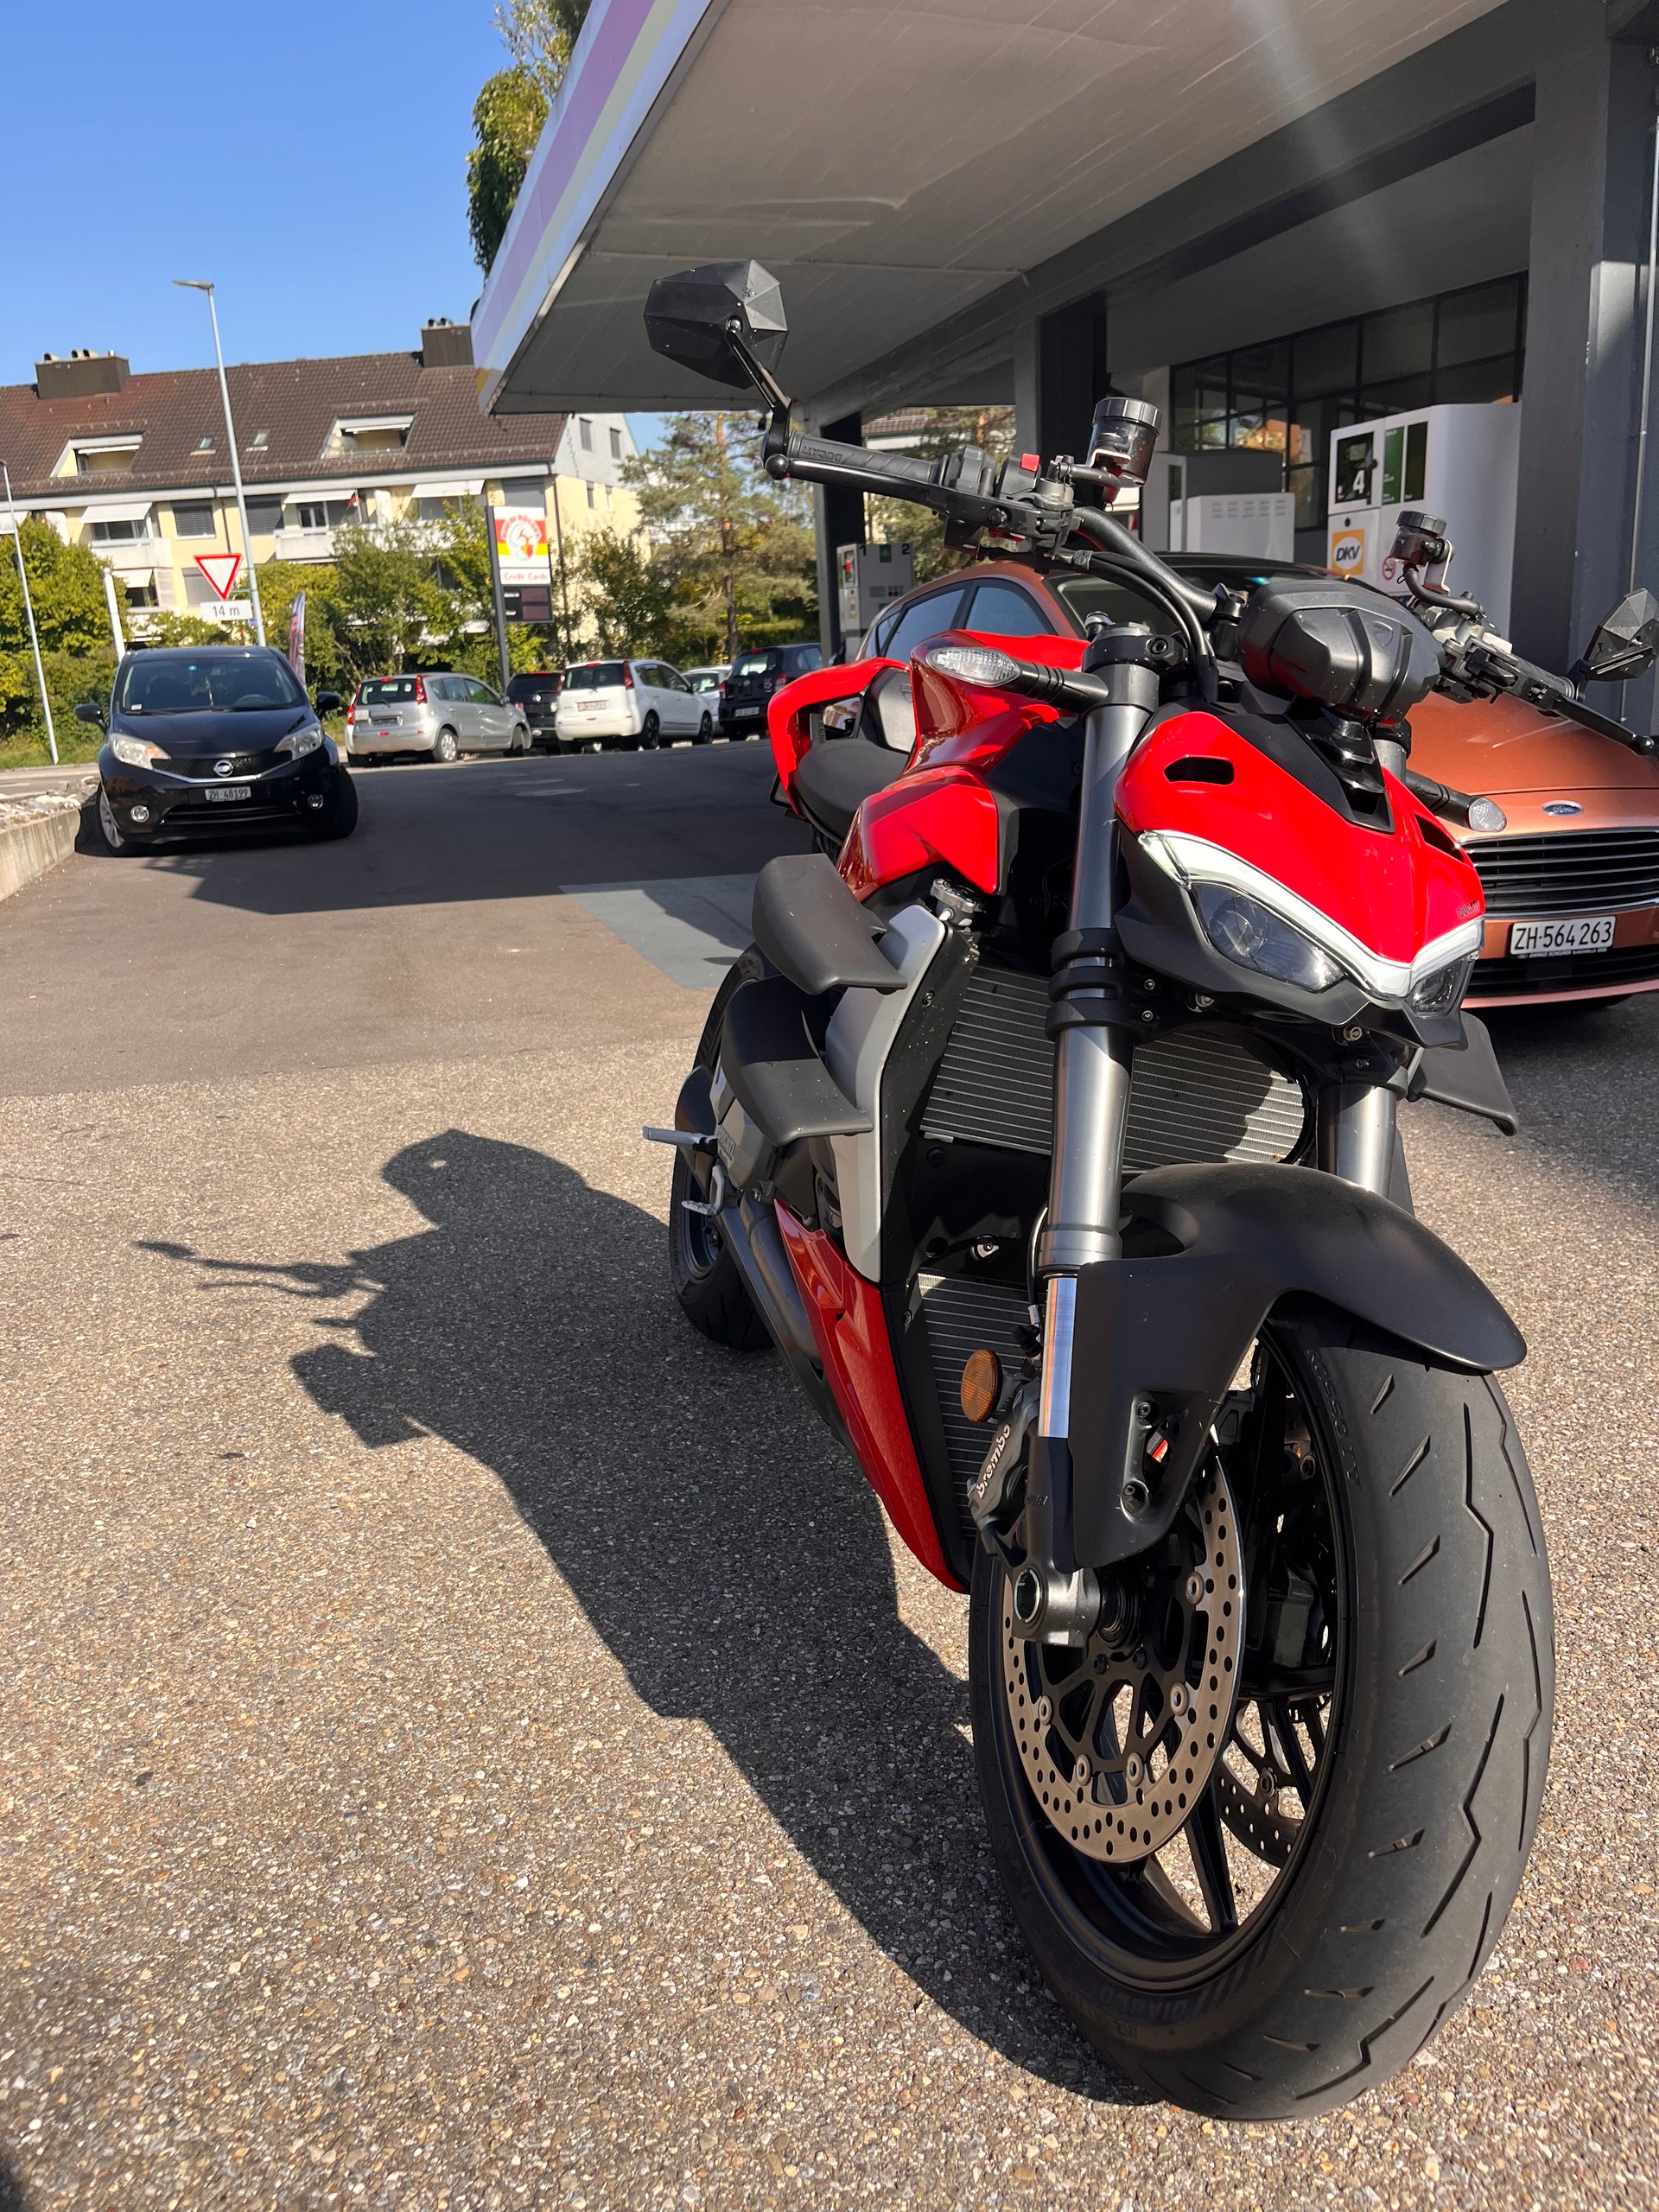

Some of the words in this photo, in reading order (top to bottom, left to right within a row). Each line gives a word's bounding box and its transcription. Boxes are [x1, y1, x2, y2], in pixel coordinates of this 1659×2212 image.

[1353, 470, 1365, 494] 4
[860, 544, 867, 556] 1
[901, 543, 911, 555] 2
[1336, 545, 1360, 562] DKV
[213, 606, 226, 617] 14
[230, 607, 239, 616] m
[976, 1424, 1011, 1499] brembo
